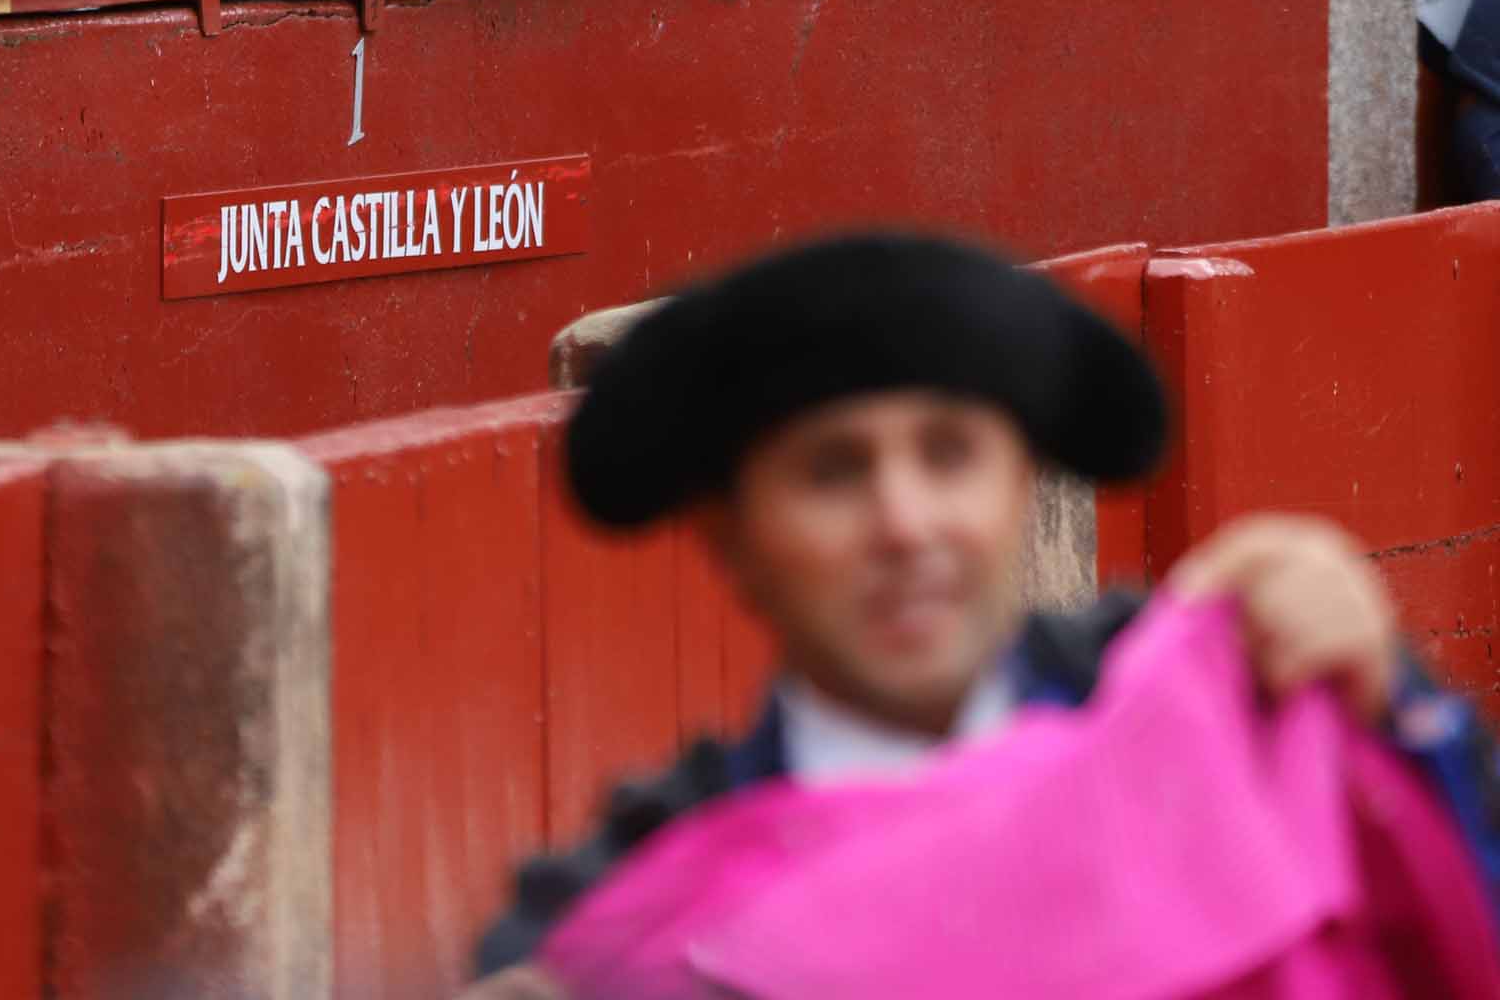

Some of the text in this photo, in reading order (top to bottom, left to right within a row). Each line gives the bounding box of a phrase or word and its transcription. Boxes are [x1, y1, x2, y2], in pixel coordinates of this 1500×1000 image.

[347, 37, 365, 147] 1
[217, 169, 545, 284] JUNTA CASTILLA Y LEÓN
